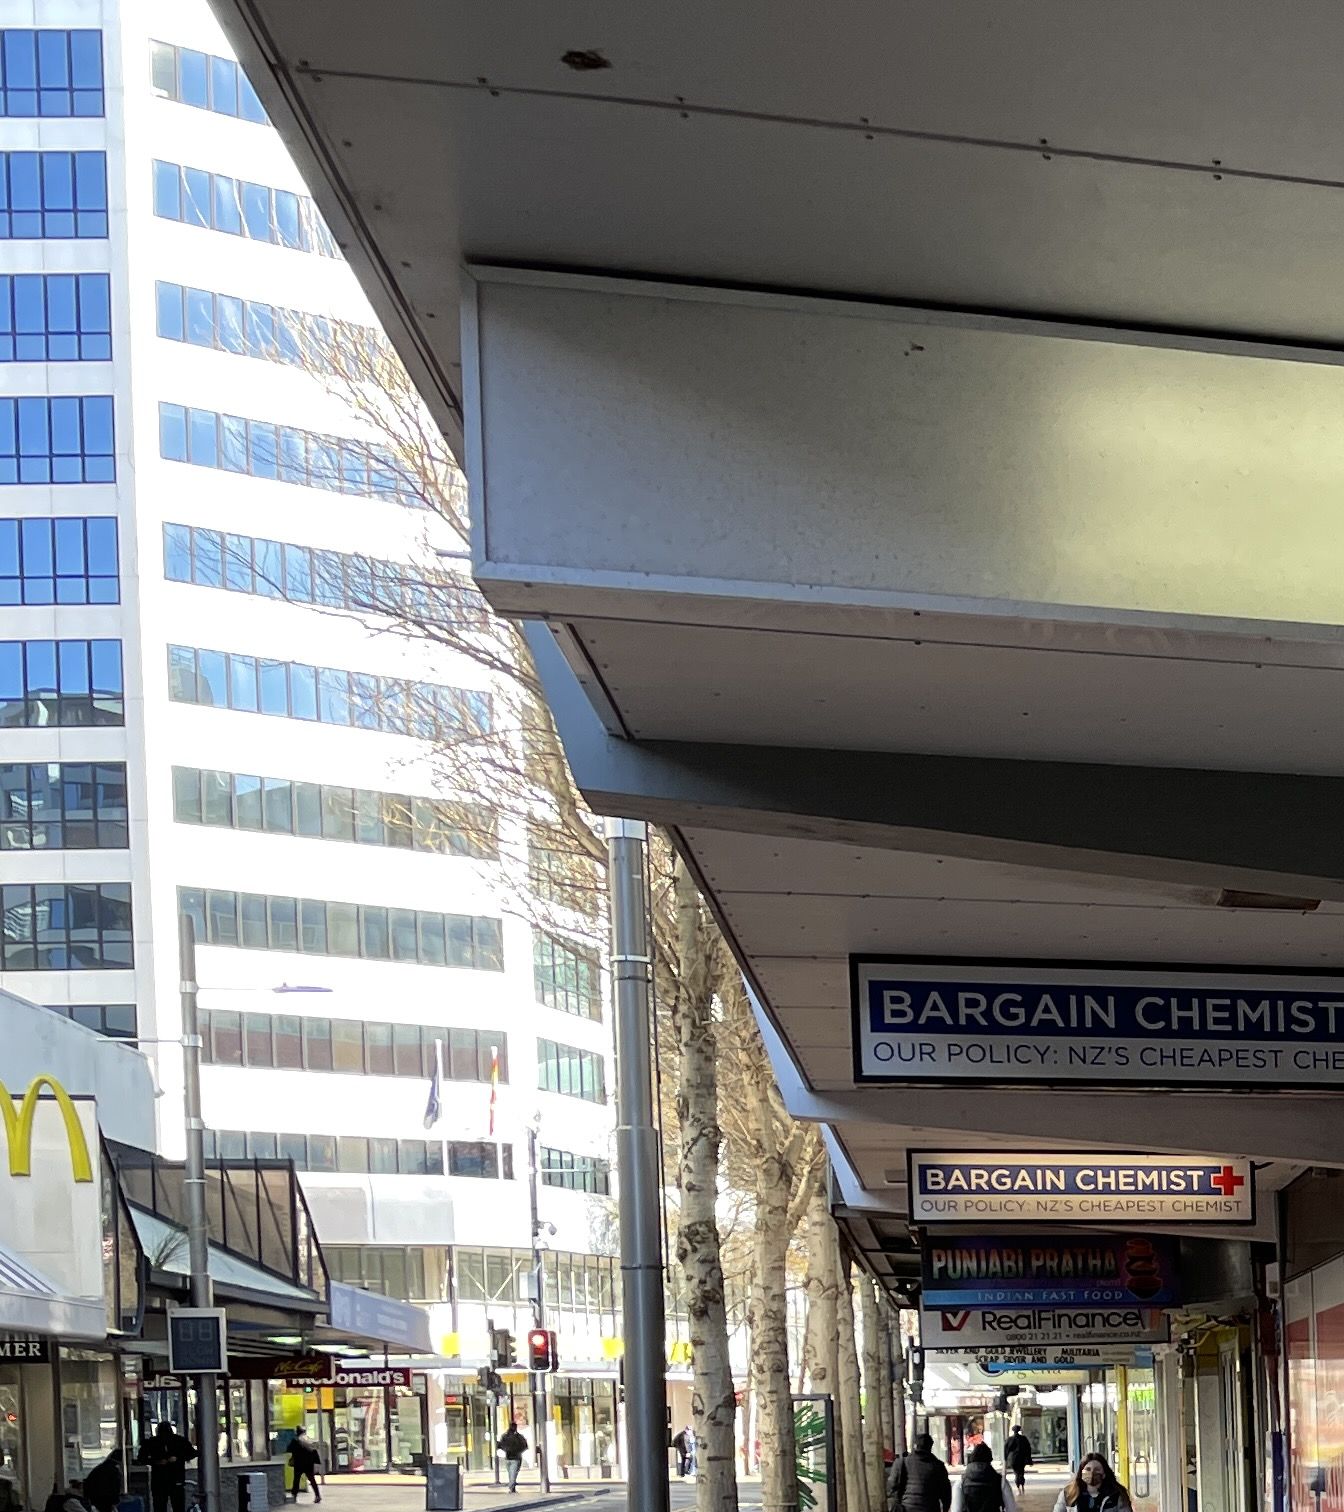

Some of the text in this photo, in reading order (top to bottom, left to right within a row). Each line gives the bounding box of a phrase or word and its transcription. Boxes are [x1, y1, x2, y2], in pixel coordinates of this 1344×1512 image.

[882, 988, 1344, 1034] BARGAIN CHEMIST
[873, 1041, 936, 1063] OUR
[947, 1043, 1058, 1067] POLICY:
[1068, 1045, 1129, 1067] NZ'S
[1139, 1046, 1284, 1069] CHEAPEST
[926, 1168, 1204, 1192] BARGAIN CHEMIST
[920, 1199, 959, 1213] OUR
[1036, 1200, 1074, 1213] NZ'S
[1079, 1200, 1167, 1213] CHEAPEST
[1172, 1200, 1242, 1214] CHEMIST
[932, 1250, 1024, 1280] PUNJABI
[977, 1290, 1124, 1301] INDIAN FAST FOOD
[981, 1308, 1142, 1331] RealFinance
[1005, 1332, 1063, 1341] 0800 21 21 21
[975, 1356, 1000, 1364] SCRAP
[1031, 1356, 1048, 1364] AND
[1053, 1356, 1075, 1364] GOLD
[985, 1347, 1006, 1355] GOLD
